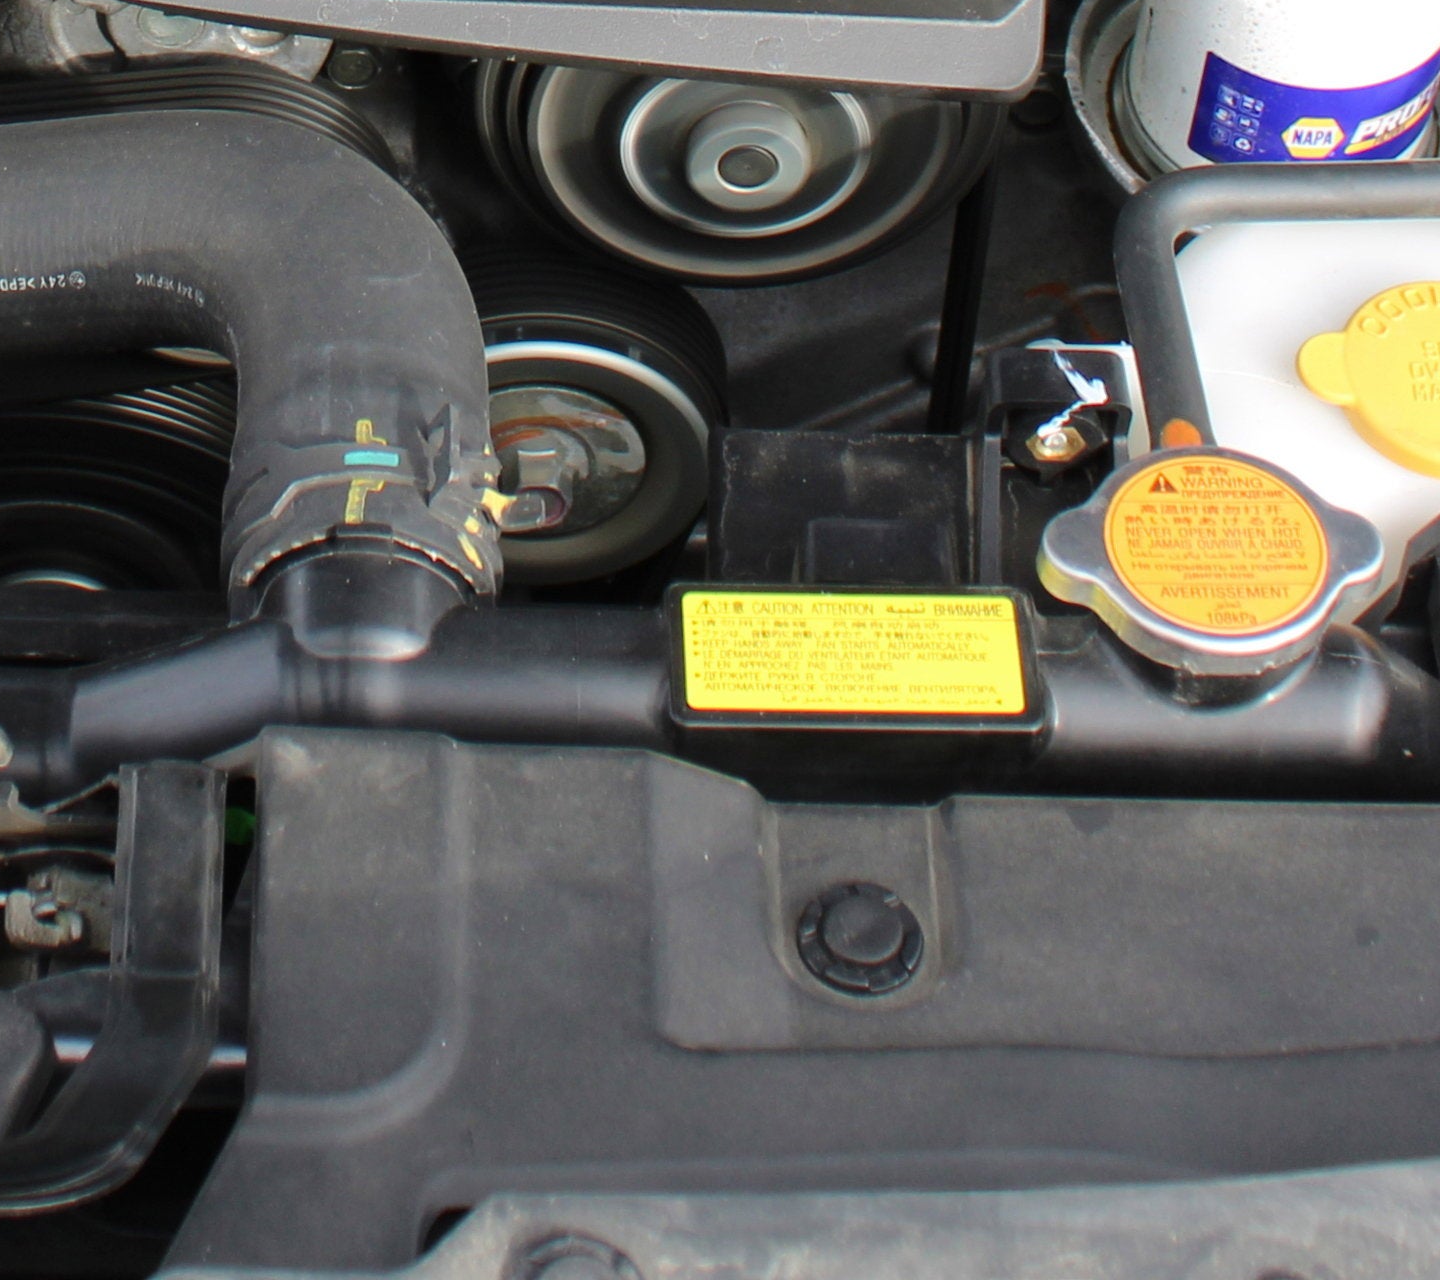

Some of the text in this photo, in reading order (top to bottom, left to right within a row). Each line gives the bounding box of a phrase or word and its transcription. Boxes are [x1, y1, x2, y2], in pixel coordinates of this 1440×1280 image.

[1292, 128, 1334, 146] NAPA
[1180, 477, 1263, 489] WARNING
[1125, 527, 1172, 538] NEVER
[1178, 528, 1217, 538] OPEN
[1222, 528, 1266, 539] WHEN
[1128, 539, 1143, 549] NE
[1148, 539, 1192, 549] JAMAIS
[1197, 539, 1242, 549] OUVRIR
[1160, 586, 1290, 599] AVERTISSEMENT
[752, 601, 803, 615] CAUTION
[811, 602, 874, 616] ATTENTION
[933, 602, 1003, 618] ВНИМАНИЕ
[1207, 612, 1258, 626] 108kPa
[702, 640, 728, 649] KEEP
[734, 640, 770, 649] HANDS
[816, 641, 836, 650] FAN
[841, 641, 880, 650] STARTS
[808, 661, 827, 670] PAS
